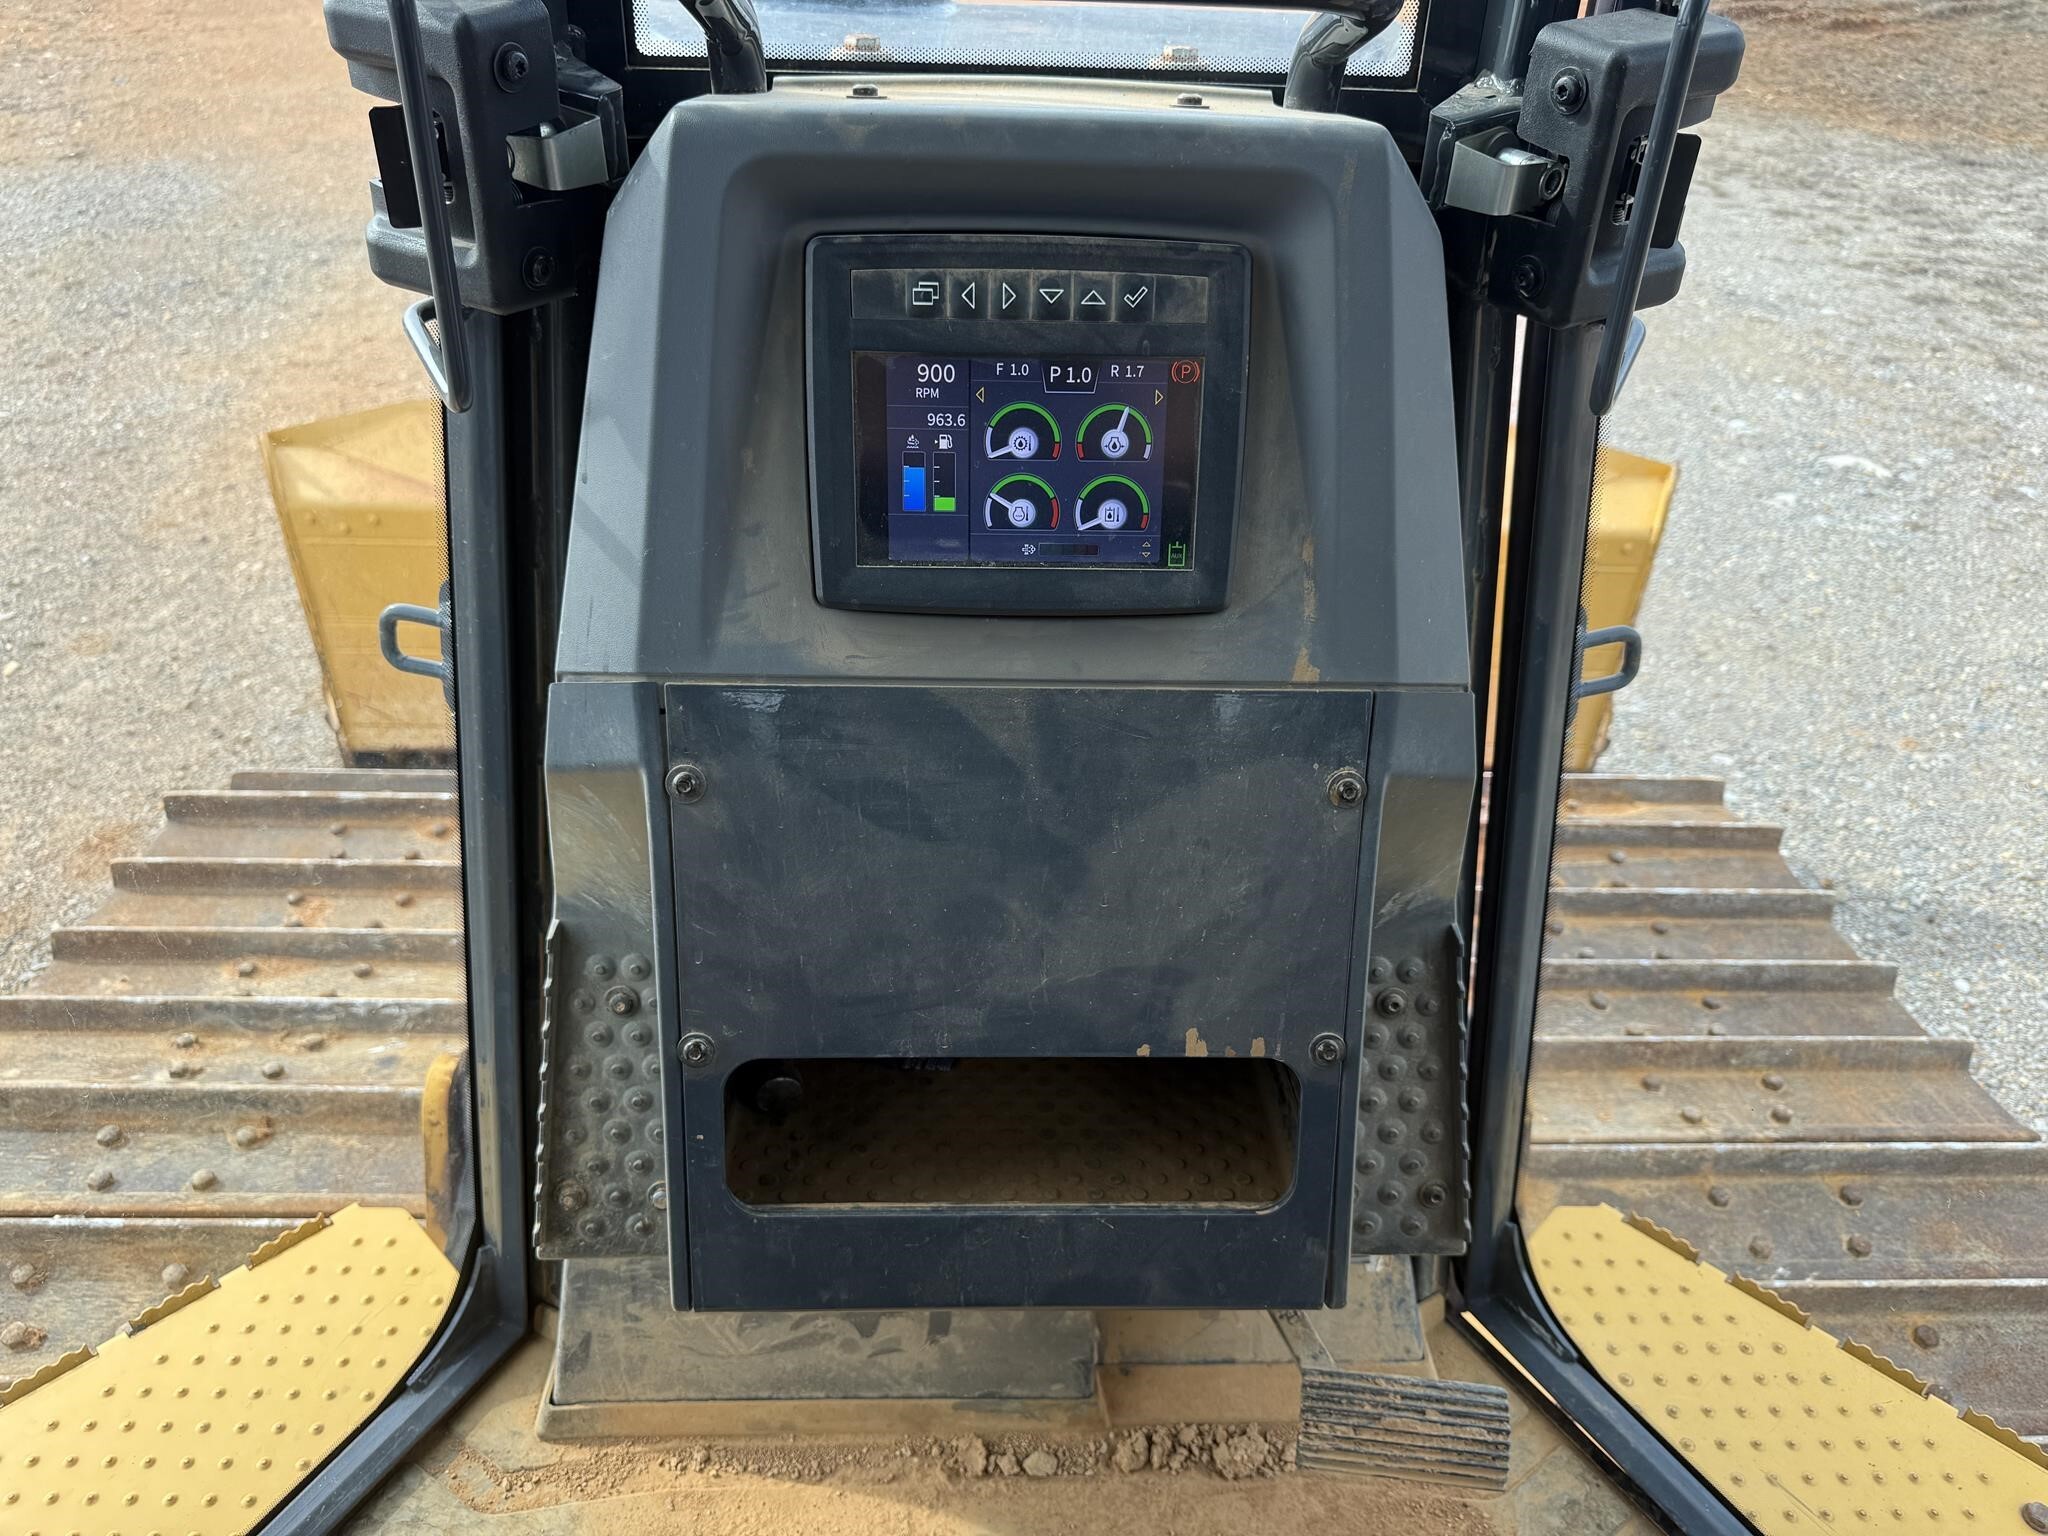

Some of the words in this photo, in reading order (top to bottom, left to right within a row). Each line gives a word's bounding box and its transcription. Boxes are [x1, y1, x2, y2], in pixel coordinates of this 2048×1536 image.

[917, 363, 955, 383] 900
[996, 362, 1004, 376] F
[1010, 363, 1029, 376] 1.0
[1050, 365, 1061, 383] P
[1066, 366, 1092, 383] 1.0
[1110, 364, 1119, 378] R
[1125, 365, 1145, 378] 1.7
[1181, 364, 1192, 379] P
[915, 387, 940, 399] RPM
[927, 413, 966, 427] 963.6
